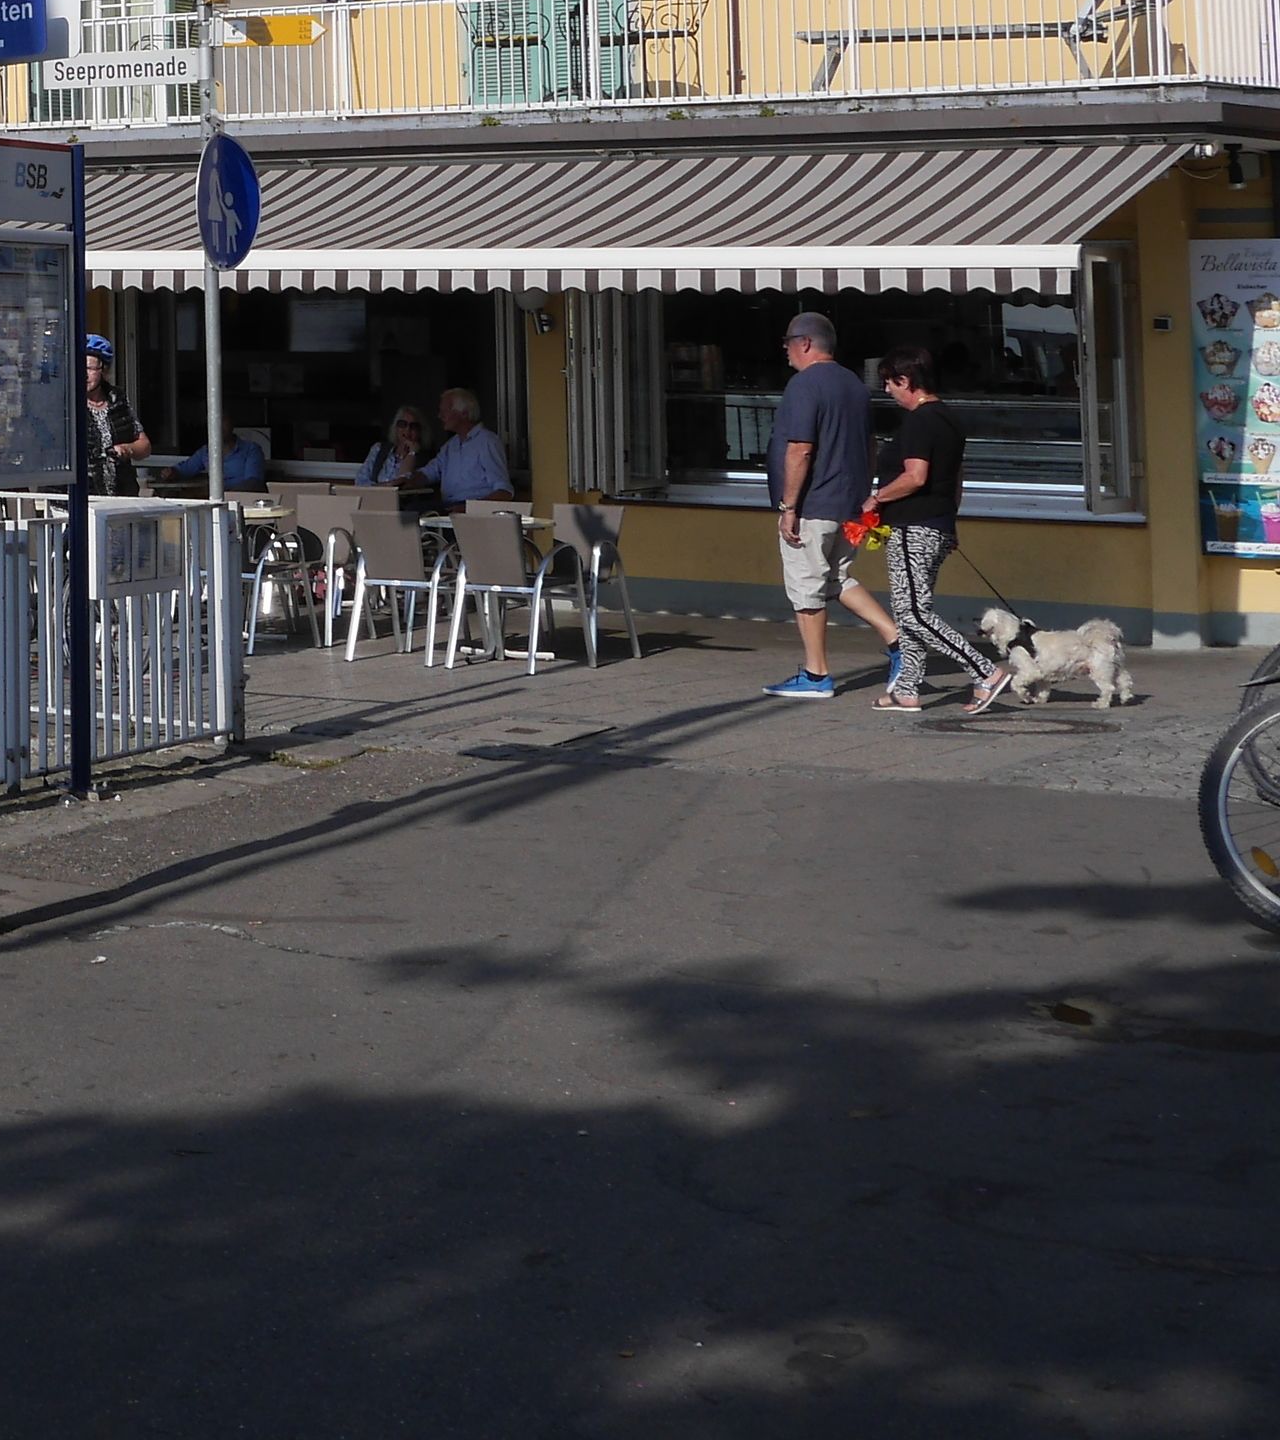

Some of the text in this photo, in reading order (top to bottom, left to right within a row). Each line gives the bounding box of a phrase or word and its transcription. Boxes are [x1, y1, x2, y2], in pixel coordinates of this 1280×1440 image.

[54, 56, 187, 85] Seepromenade
[15, 162, 48, 189] BSB
[1200, 253, 1278, 271] Bellavista
